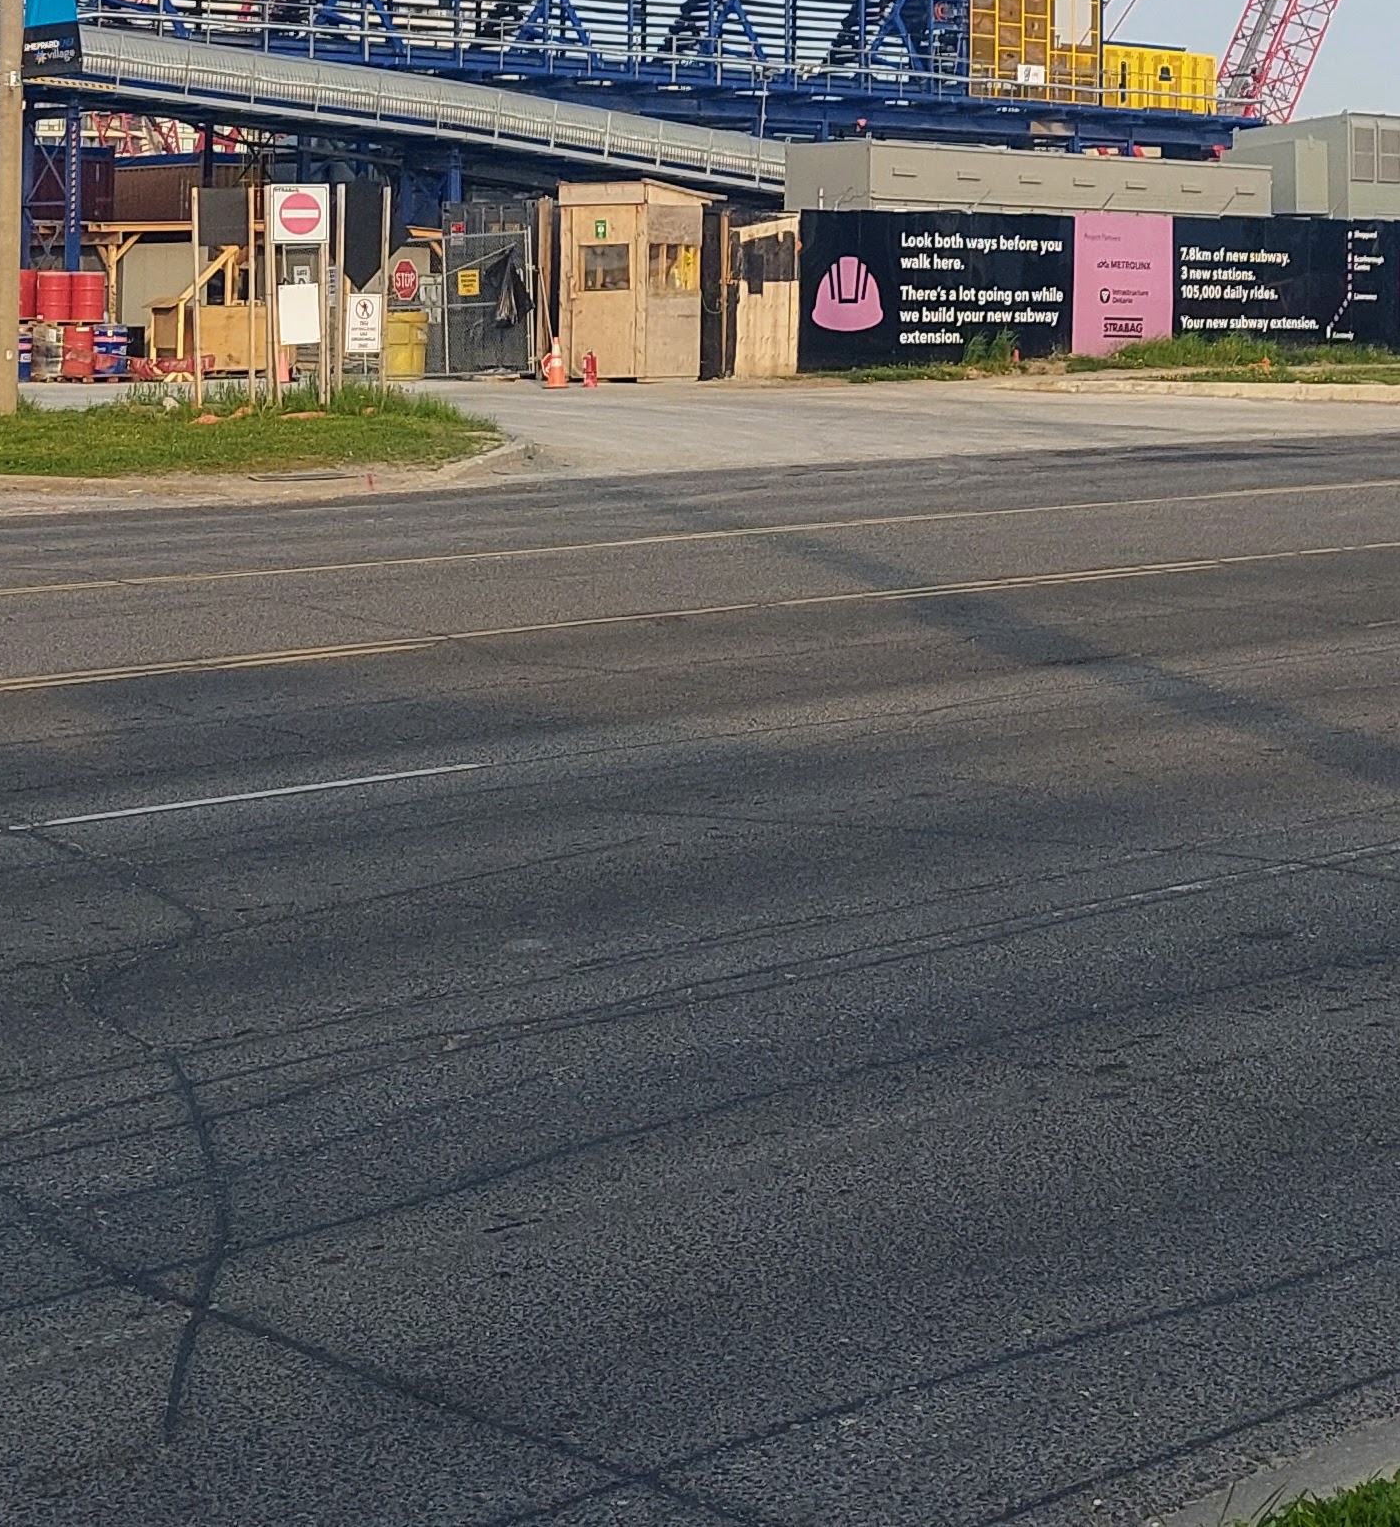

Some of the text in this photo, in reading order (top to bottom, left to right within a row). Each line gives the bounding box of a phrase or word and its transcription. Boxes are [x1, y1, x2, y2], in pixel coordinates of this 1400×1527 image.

[47, 47, 75, 62] village
[901, 231, 1063, 256] Look both ways before you
[900, 253, 931, 269] walk
[1180, 246, 1291, 267] 7.8km of new subway.
[1110, 260, 1151, 270] METROLINX
[395, 272, 415, 288] STOP
[1180, 267, 1256, 281] 3 new stations.
[900, 284, 1064, 305] There's a lot going on while
[1180, 285, 1279, 303] 105,000 daily rides.
[899, 306, 1060, 327] we build your new subway
[1180, 315, 1320, 333] Your new subway extension.
[899, 328, 964, 344] extension.
[1103, 322, 1144, 334] STRABAG
